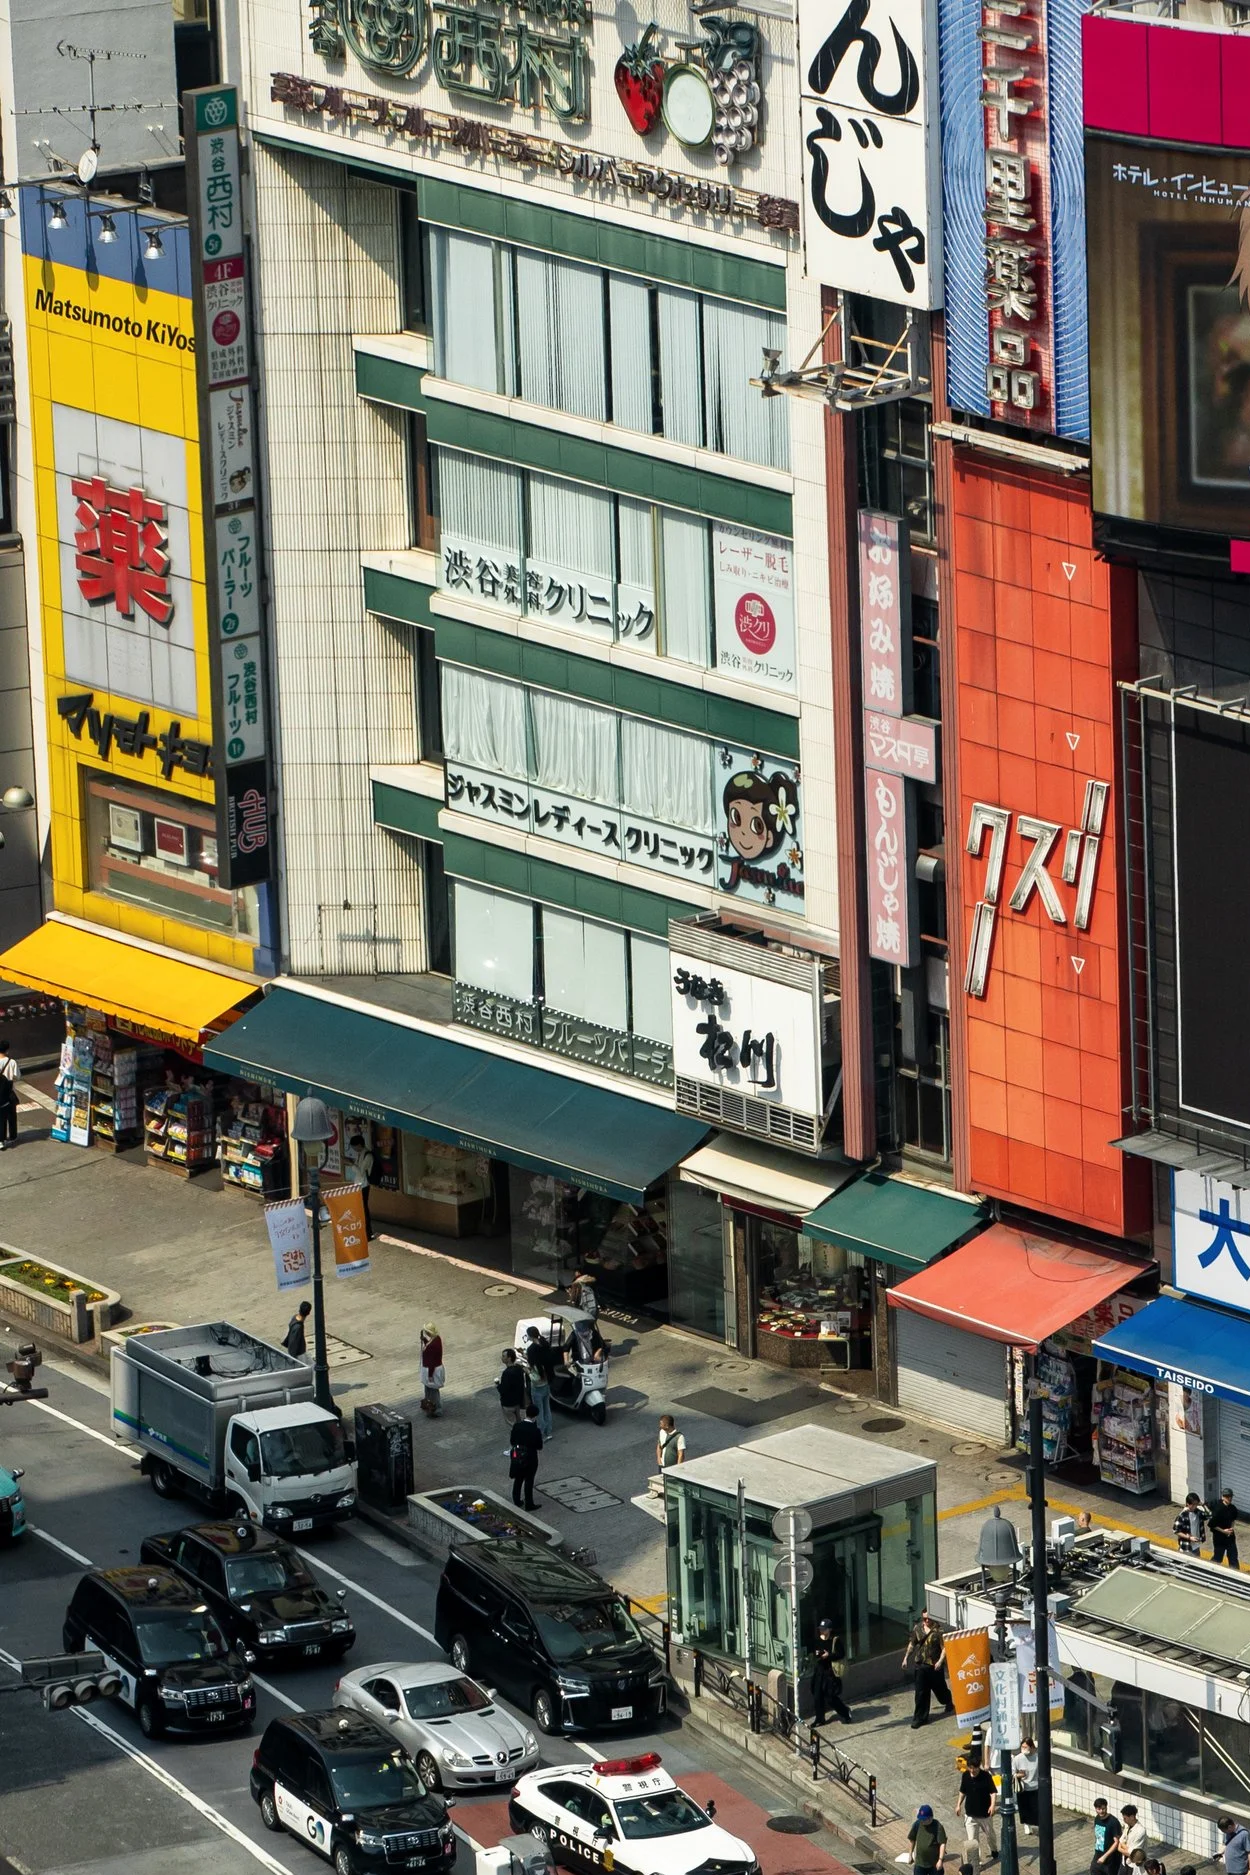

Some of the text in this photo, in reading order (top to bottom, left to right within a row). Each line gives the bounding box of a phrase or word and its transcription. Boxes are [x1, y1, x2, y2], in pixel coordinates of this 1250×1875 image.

[310, 0, 345, 59] 谷
[432, 3, 593, 123] 西村
[207, 137, 233, 231] 渋谷西村
[1153, 189, 1189, 201] HOTEL
[206, 283, 230, 300] 渋谷
[214, 262, 234, 281] 4F
[34, 288, 142, 339] Matsumoto
[71, 475, 175, 627] 薬
[221, 547, 235, 610] パーラー
[237, 535, 253, 599] フルーツ
[718, 540, 789, 574] レーザー脱毛
[443, 545, 656, 638] 渋谷 美容 外科 クリニック
[867, 530, 896, 703] お好み焼
[243, 661, 258, 726] 渋谷西村
[753, 660, 794, 683] クリニック
[227, 673, 242, 735] フルーツ
[57, 692, 214, 780] マツモトキヨ
[228, 795, 238, 859] BRITISH PUB
[238, 788, 268, 854] HUB
[873, 778, 901, 957] もんじゃ焼
[964, 780, 1110, 997] クスリ
[461, 991, 533, 1035] 渋谷西村
[695, 1014, 776, 1089] 松川
[1156, 1367, 1215, 1395] TAISEIDO
[956, 1665, 987, 1681] 食べログ
[622, 1777, 662, 1792] 警視庁
[549, 1828, 601, 1865] POLICE
[553, 1814, 600, 1847] 警視庁
